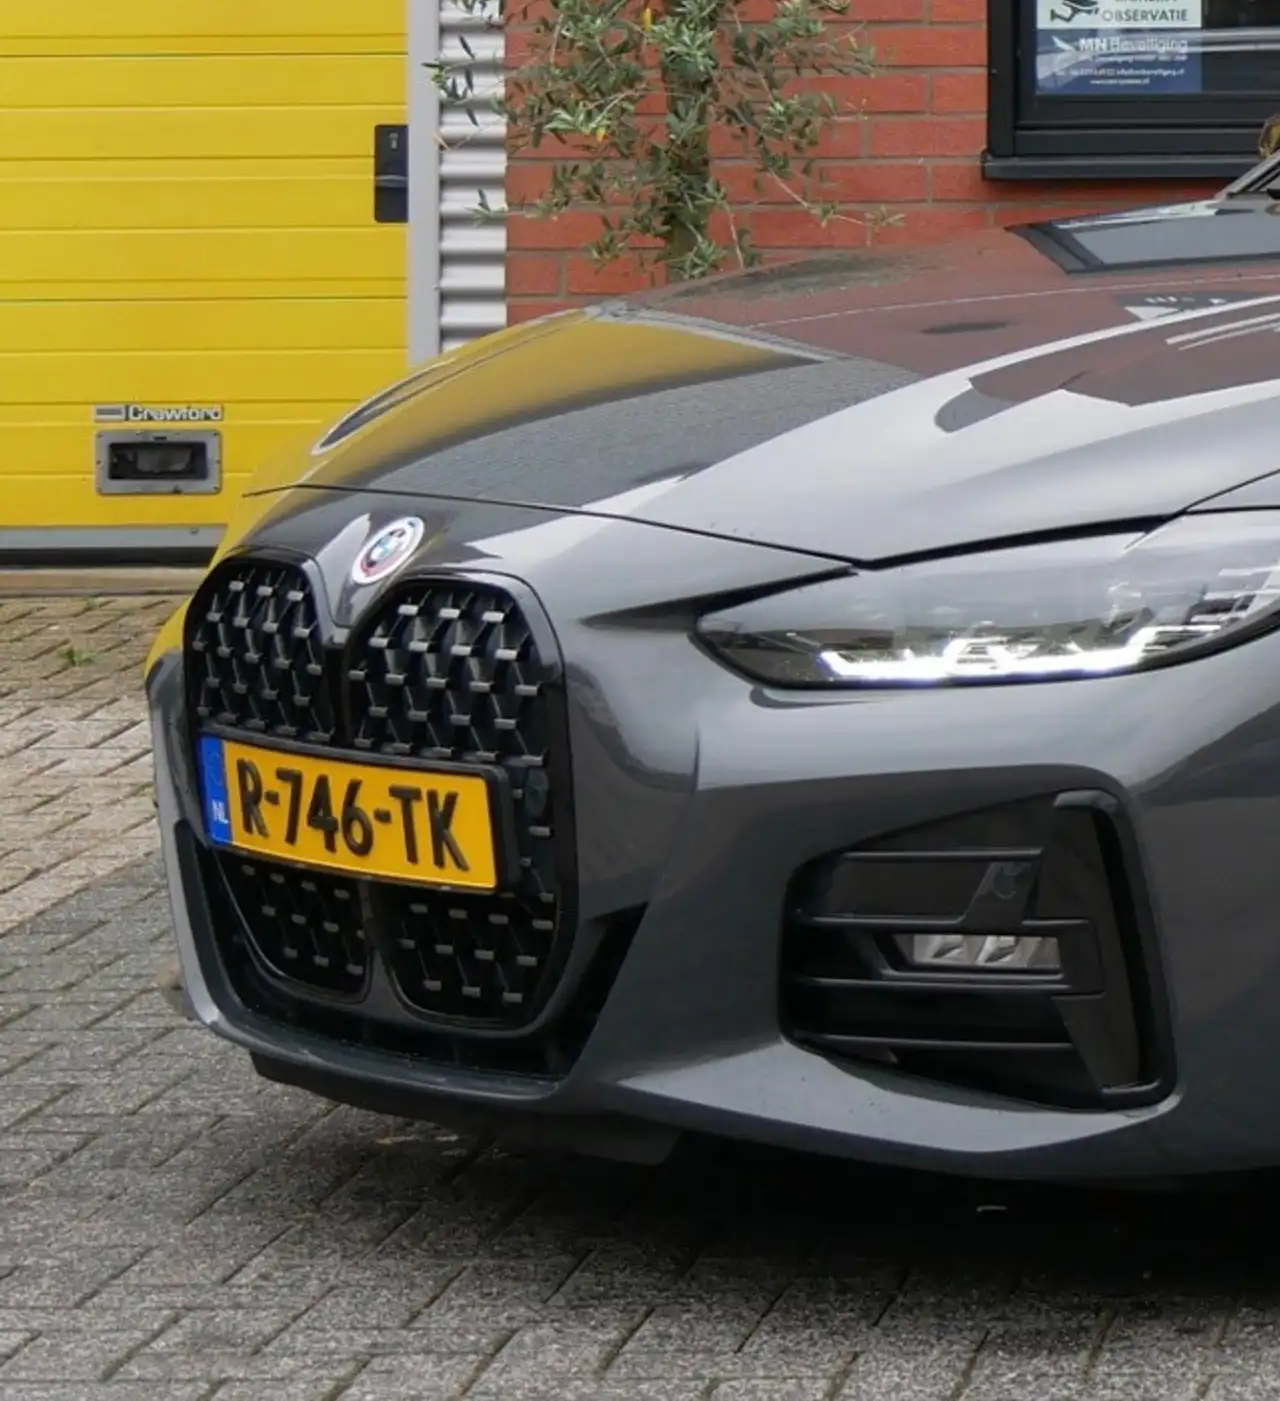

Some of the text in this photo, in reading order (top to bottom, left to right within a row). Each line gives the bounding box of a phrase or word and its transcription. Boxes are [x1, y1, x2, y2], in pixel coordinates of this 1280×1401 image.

[1100, 8, 1189, 22] OBSERVATIE
[128, 404, 222, 421] Crawford
[235, 757, 471, 872] R-746-TK
